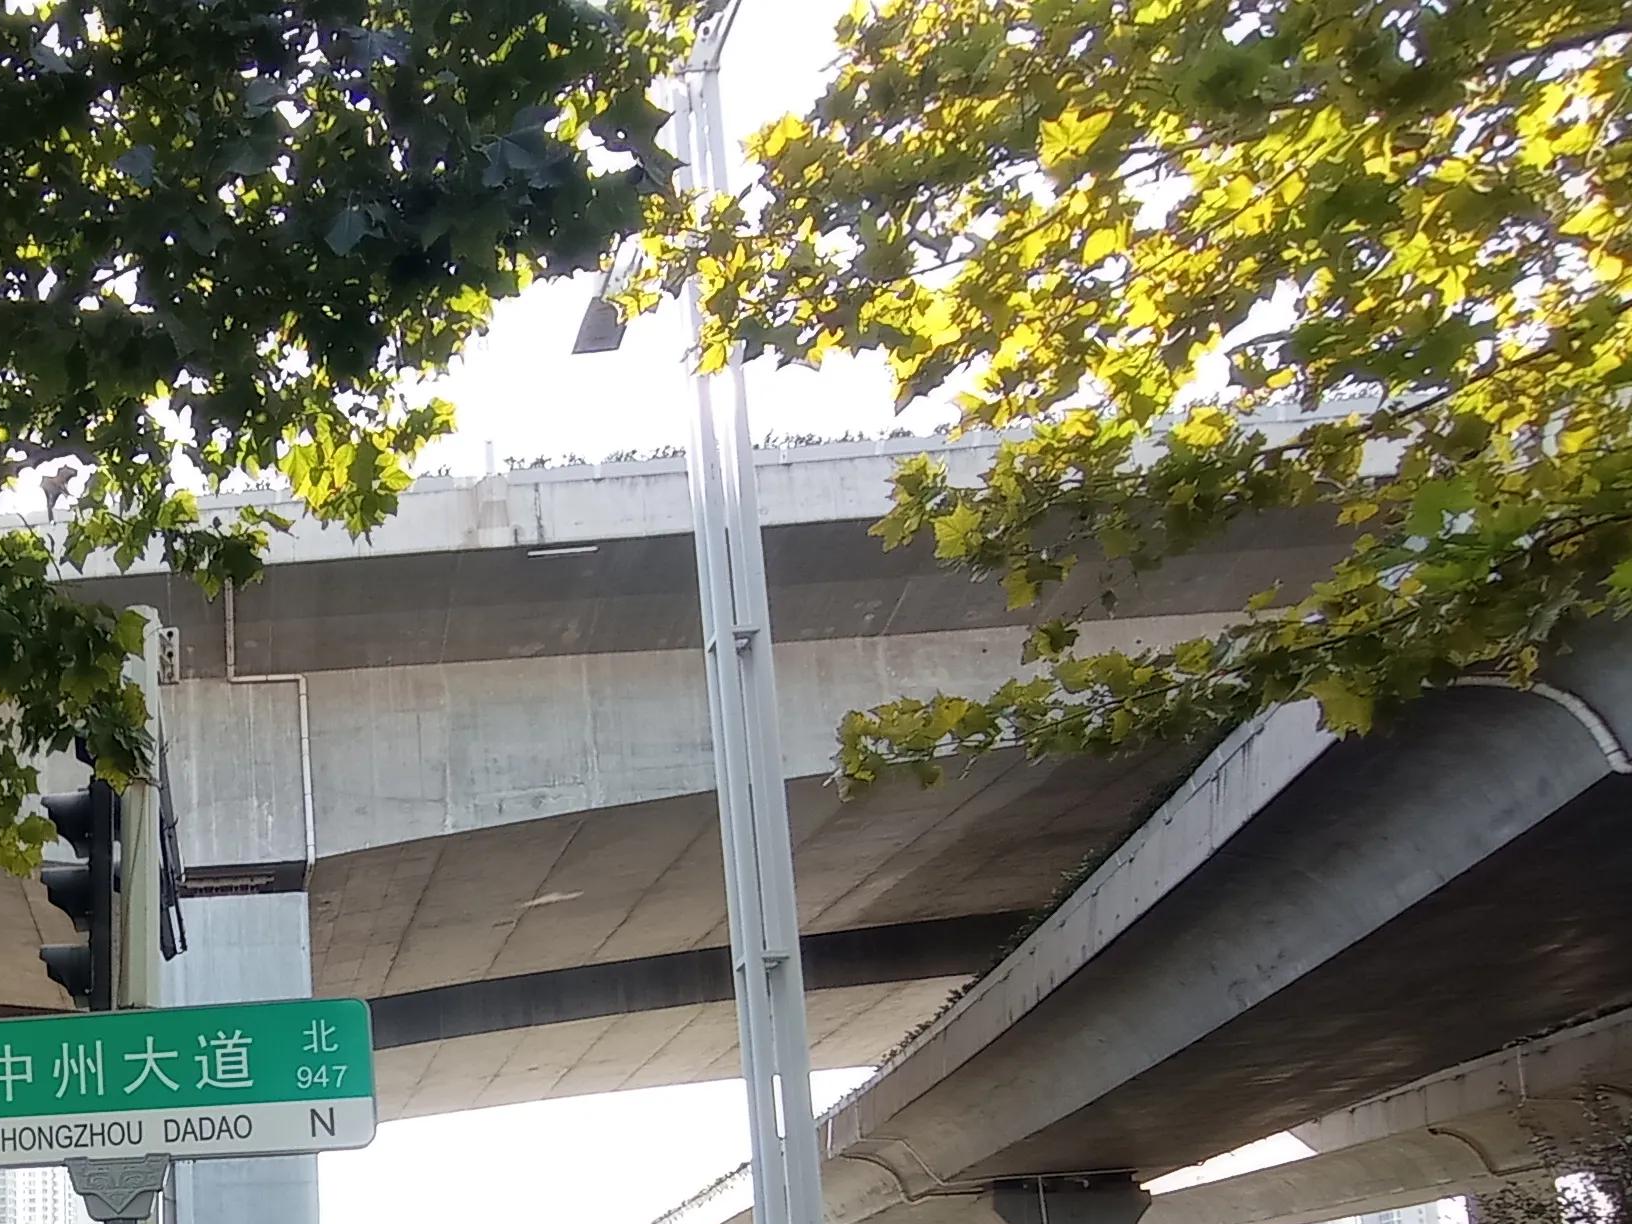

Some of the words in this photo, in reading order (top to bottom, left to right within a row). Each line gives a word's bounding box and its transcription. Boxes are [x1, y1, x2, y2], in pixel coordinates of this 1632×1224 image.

[302, 1019, 339, 1055] 北
[296, 1064, 348, 1090] 947
[163, 1113, 253, 1143] DADAO
[309, 1106, 335, 1138] N
